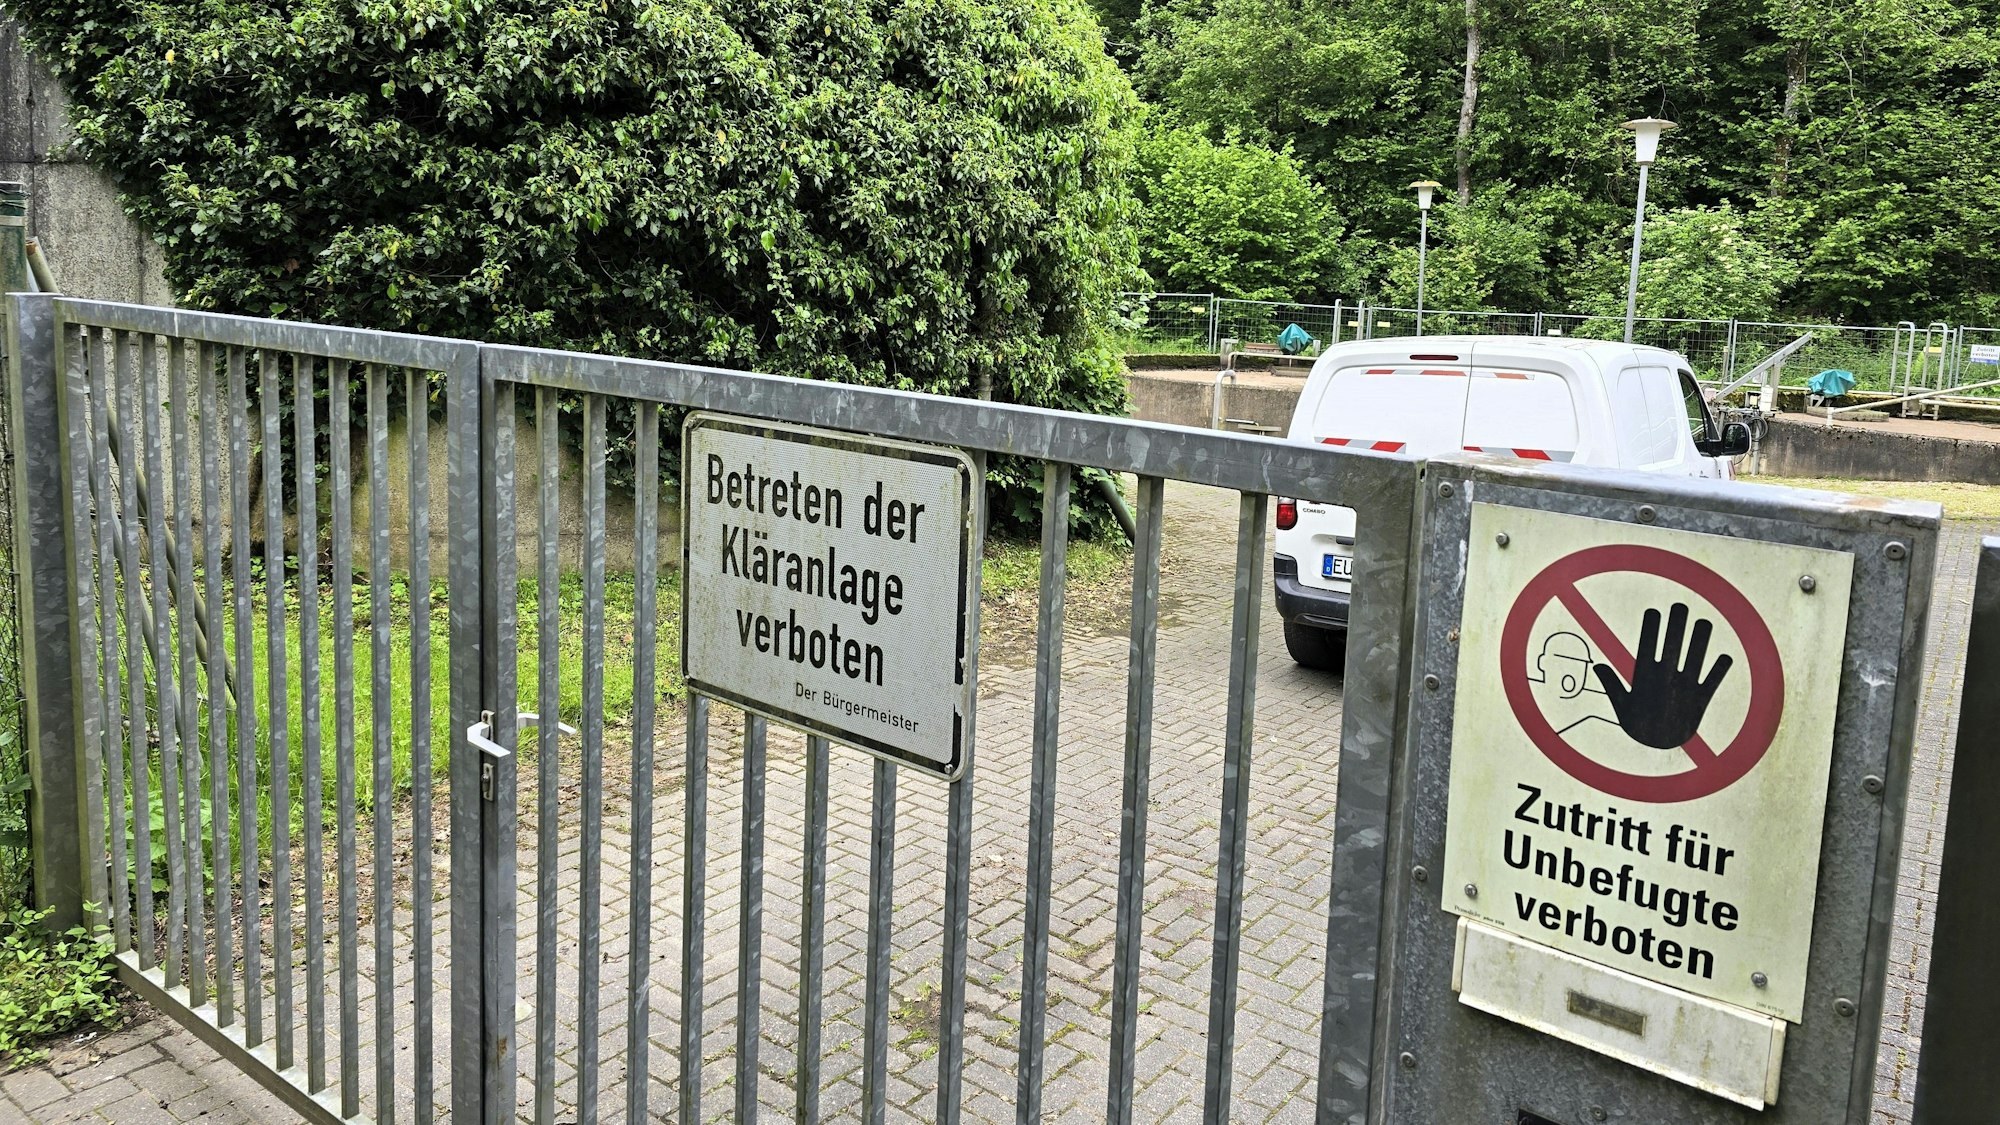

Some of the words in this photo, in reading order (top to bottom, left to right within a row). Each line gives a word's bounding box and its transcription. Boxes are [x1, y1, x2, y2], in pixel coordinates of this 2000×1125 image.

[707, 453, 843, 528] Betreten
[864, 481, 925, 543] der
[1302, 507, 1326, 515] COMBO
[722, 524, 904, 625] Kläranlage
[736, 609, 884, 686] verboten
[795, 682, 817, 704] Der
[824, 690, 919, 734] Bürgermeister
[1514, 783, 1651, 856] Zutritt
[1666, 824, 1735, 876] für
[1503, 829, 1739, 931] Unbefugte
[1514, 892, 1715, 980] verboten
